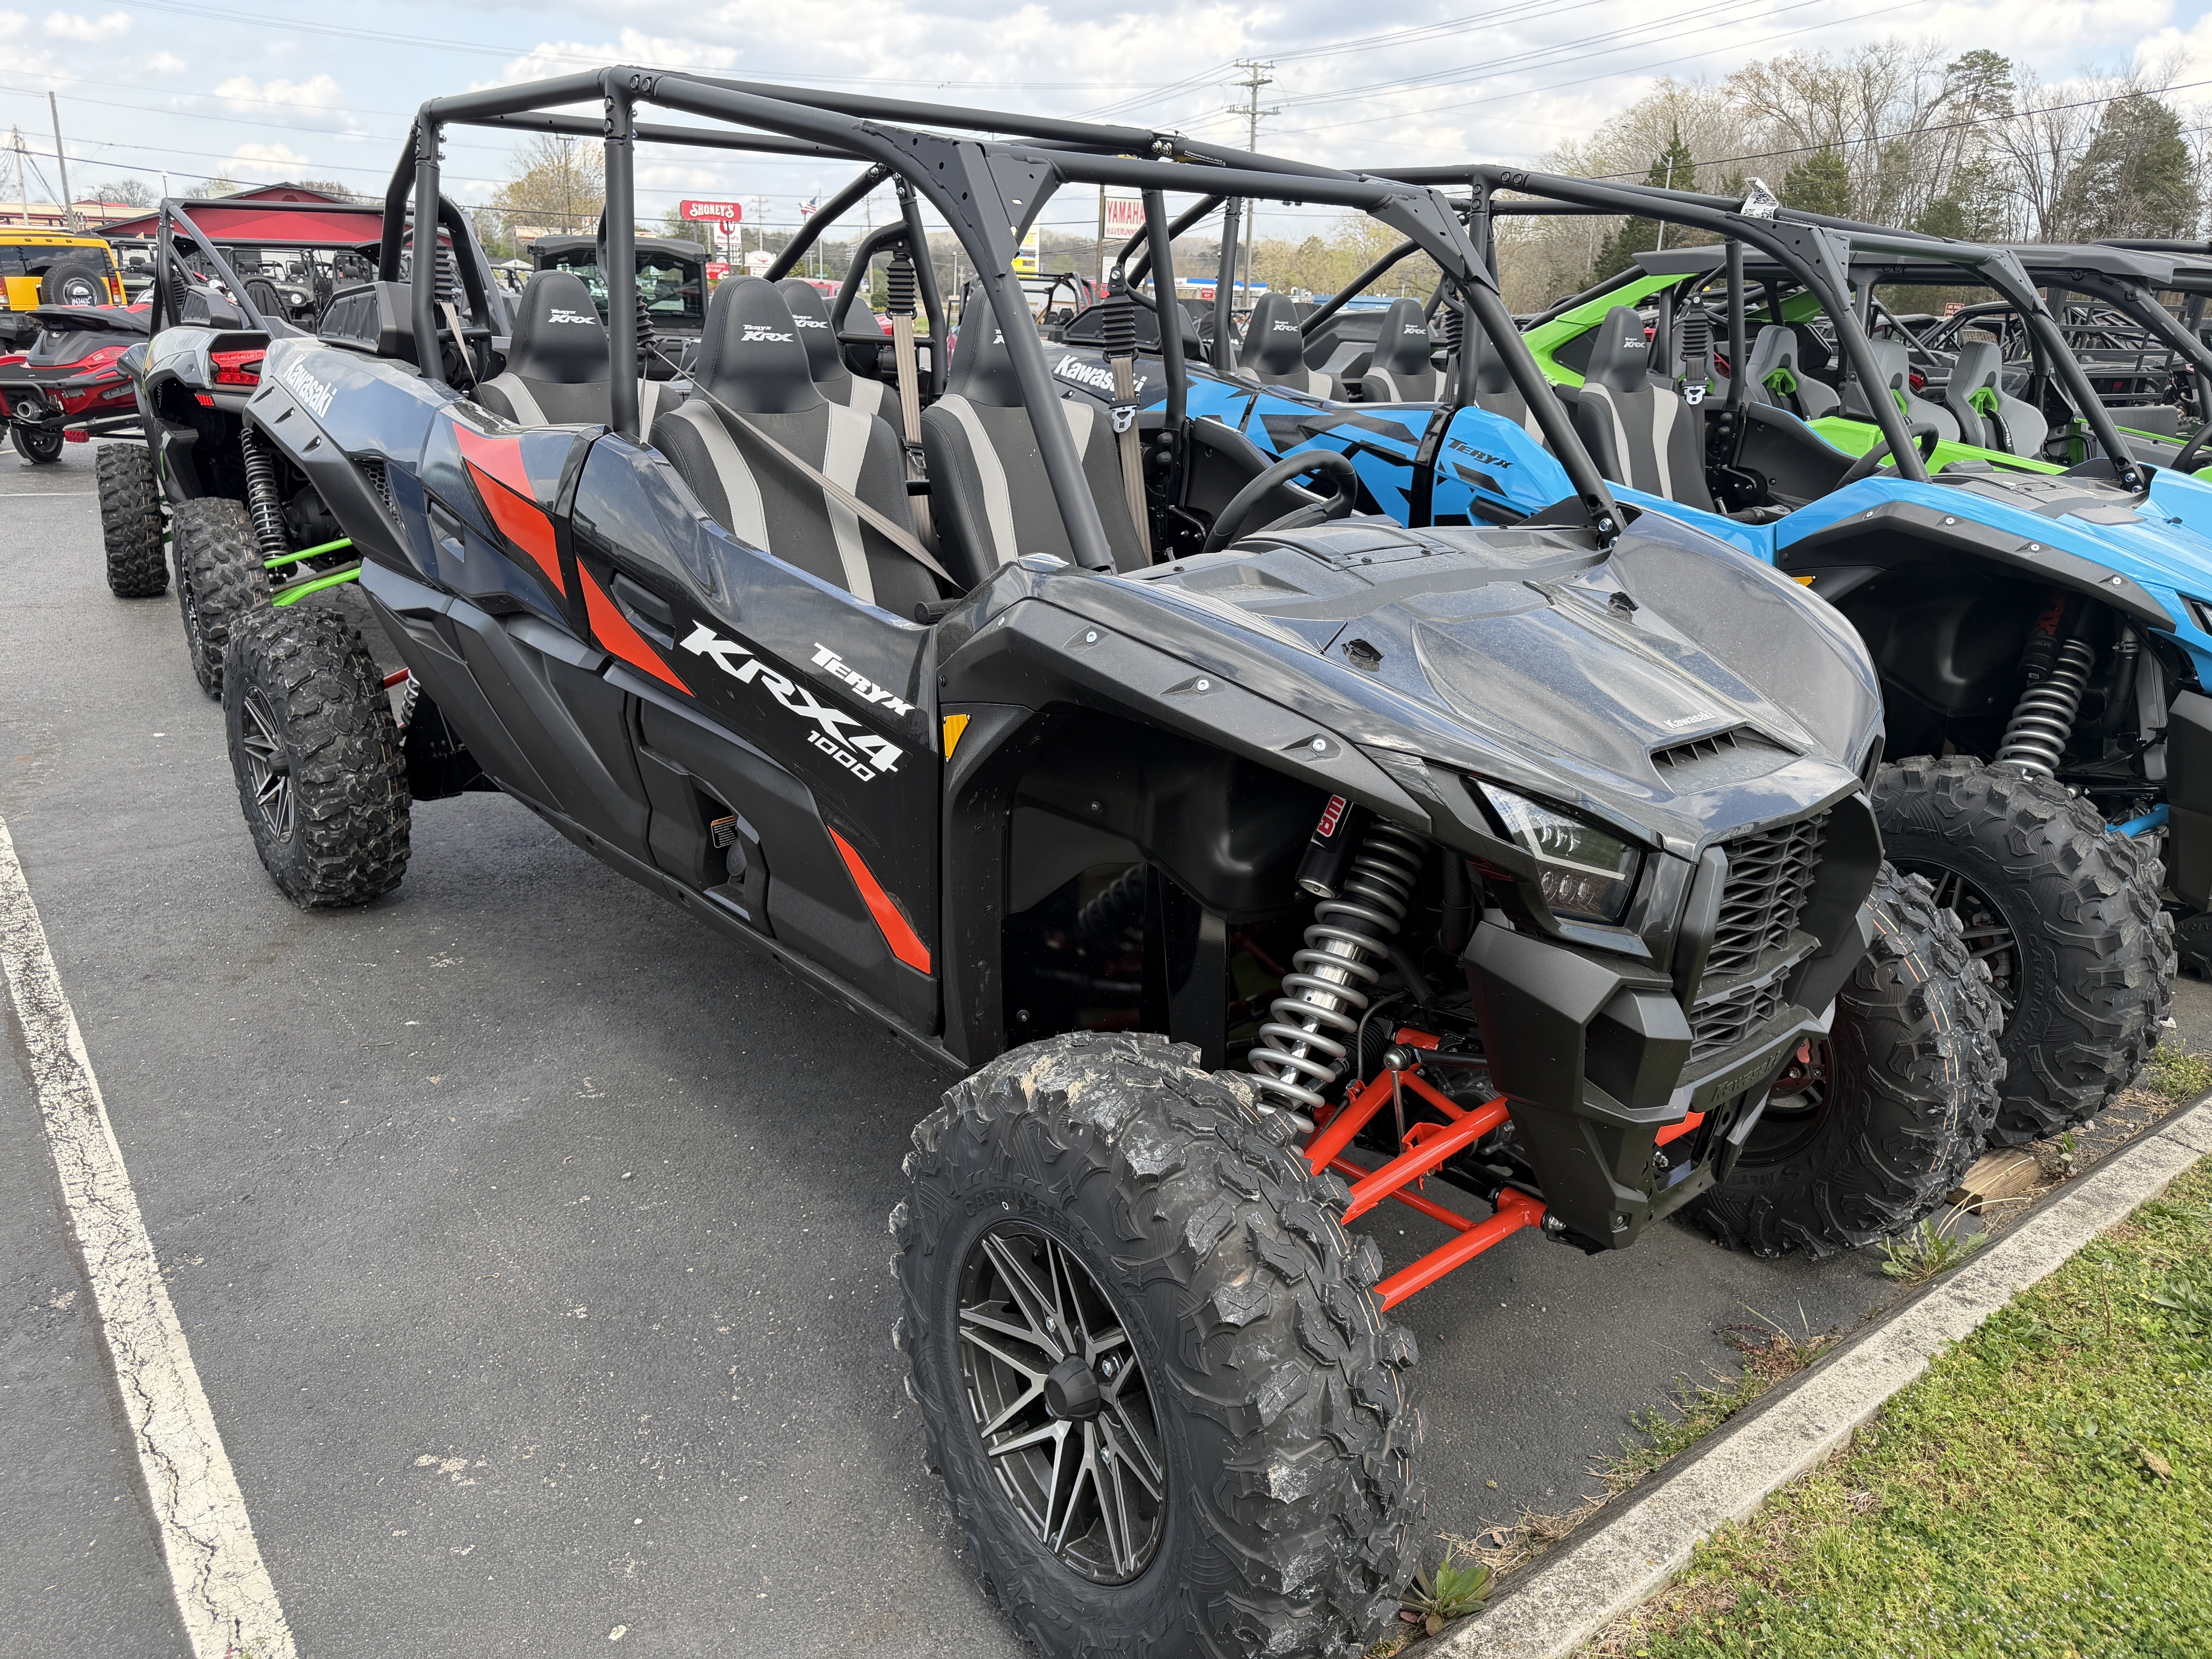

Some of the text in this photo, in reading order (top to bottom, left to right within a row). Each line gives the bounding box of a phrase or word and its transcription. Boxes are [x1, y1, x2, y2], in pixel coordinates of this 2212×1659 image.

[689, 203, 734, 218] SHONEY'S
[548, 314, 596, 325] KRX
[794, 319, 828, 328] KRX
[741, 331, 794, 342] KRX
[283, 353, 338, 419] Kawasaki
[1053, 355, 1147, 392] Kawasi
[679, 619, 899, 773] KRX4
[1663, 711, 1716, 729] Kawasaki
[807, 730, 877, 782] 1000
[1711, 1048, 1781, 1103] Kawasaki
